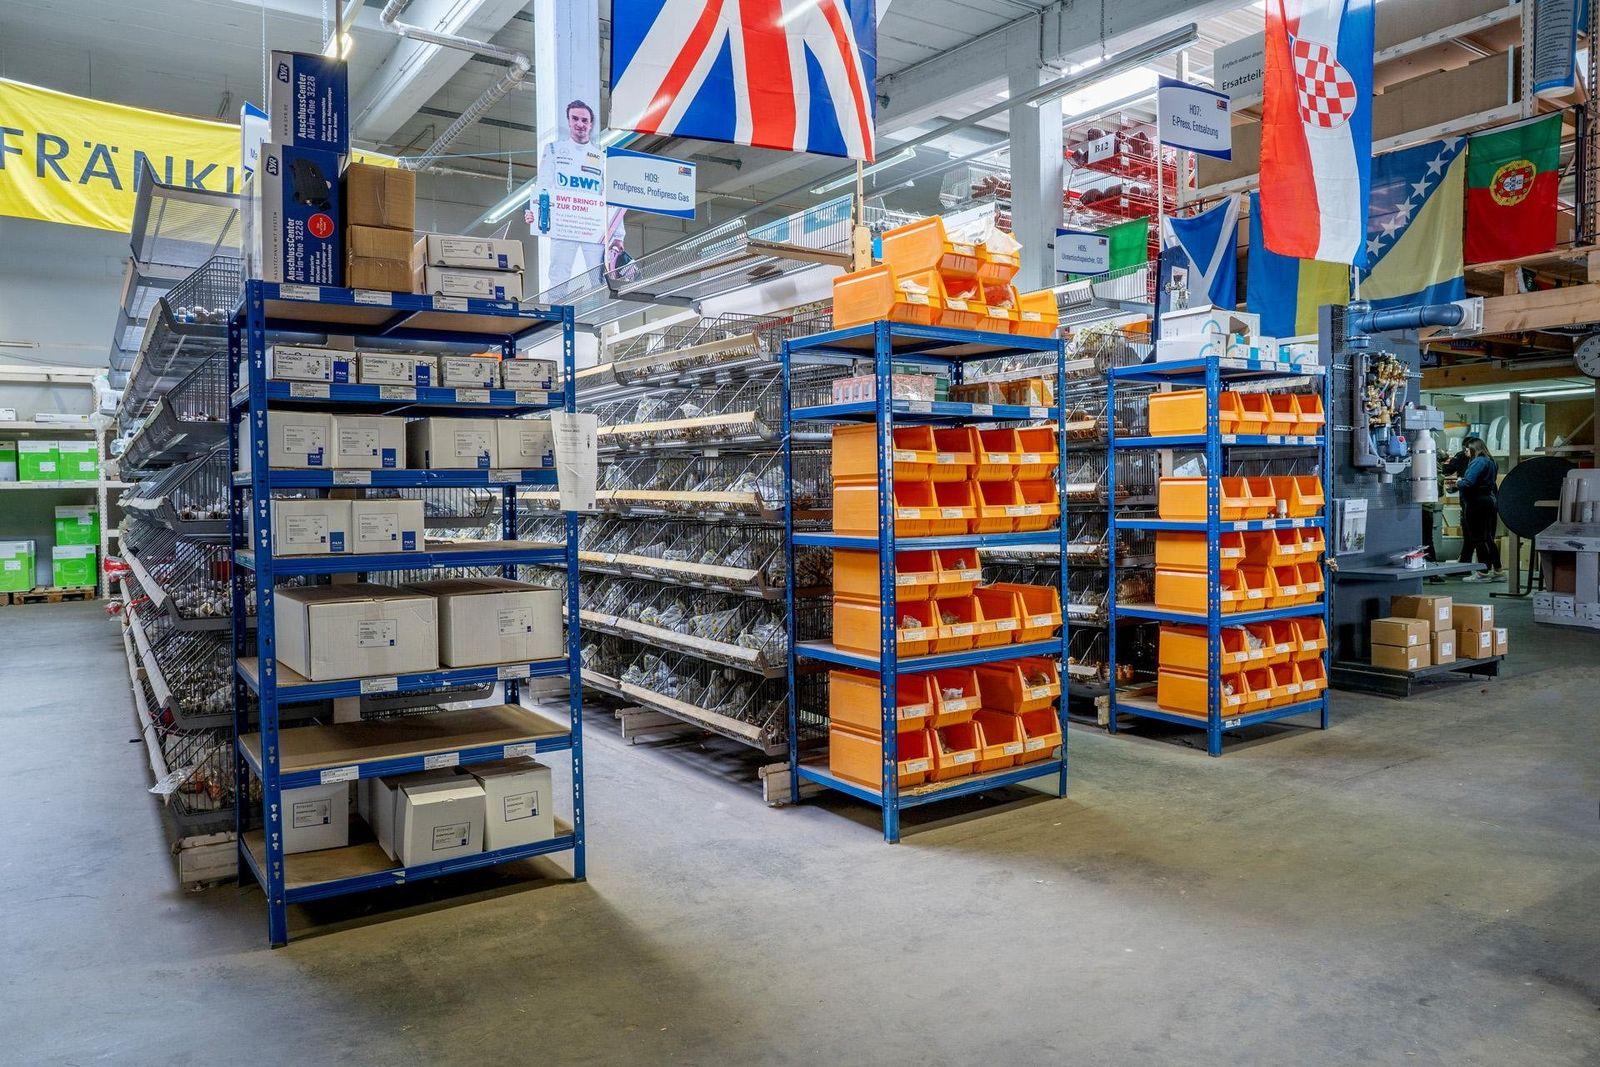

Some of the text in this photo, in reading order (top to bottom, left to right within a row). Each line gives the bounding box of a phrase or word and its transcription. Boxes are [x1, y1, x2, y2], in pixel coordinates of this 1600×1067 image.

[279, 64, 288, 82] SYR
[298, 73, 306, 138] AnschlussCenter
[307, 76, 316, 140] All-in-One 3228
[1095, 142, 1109, 154] B12
[268, 157, 277, 174] SYR
[570, 176, 600, 191] BWT
[644, 173, 660, 184] H09:
[613, 180, 690, 202] Profipress, Profipress Gas
[556, 202, 570, 210] ZUR
[572, 197, 597, 206] BRINGT
[287, 217, 295, 281] AnschlussCenter
[295, 220, 304, 282] All-in-One 3228
